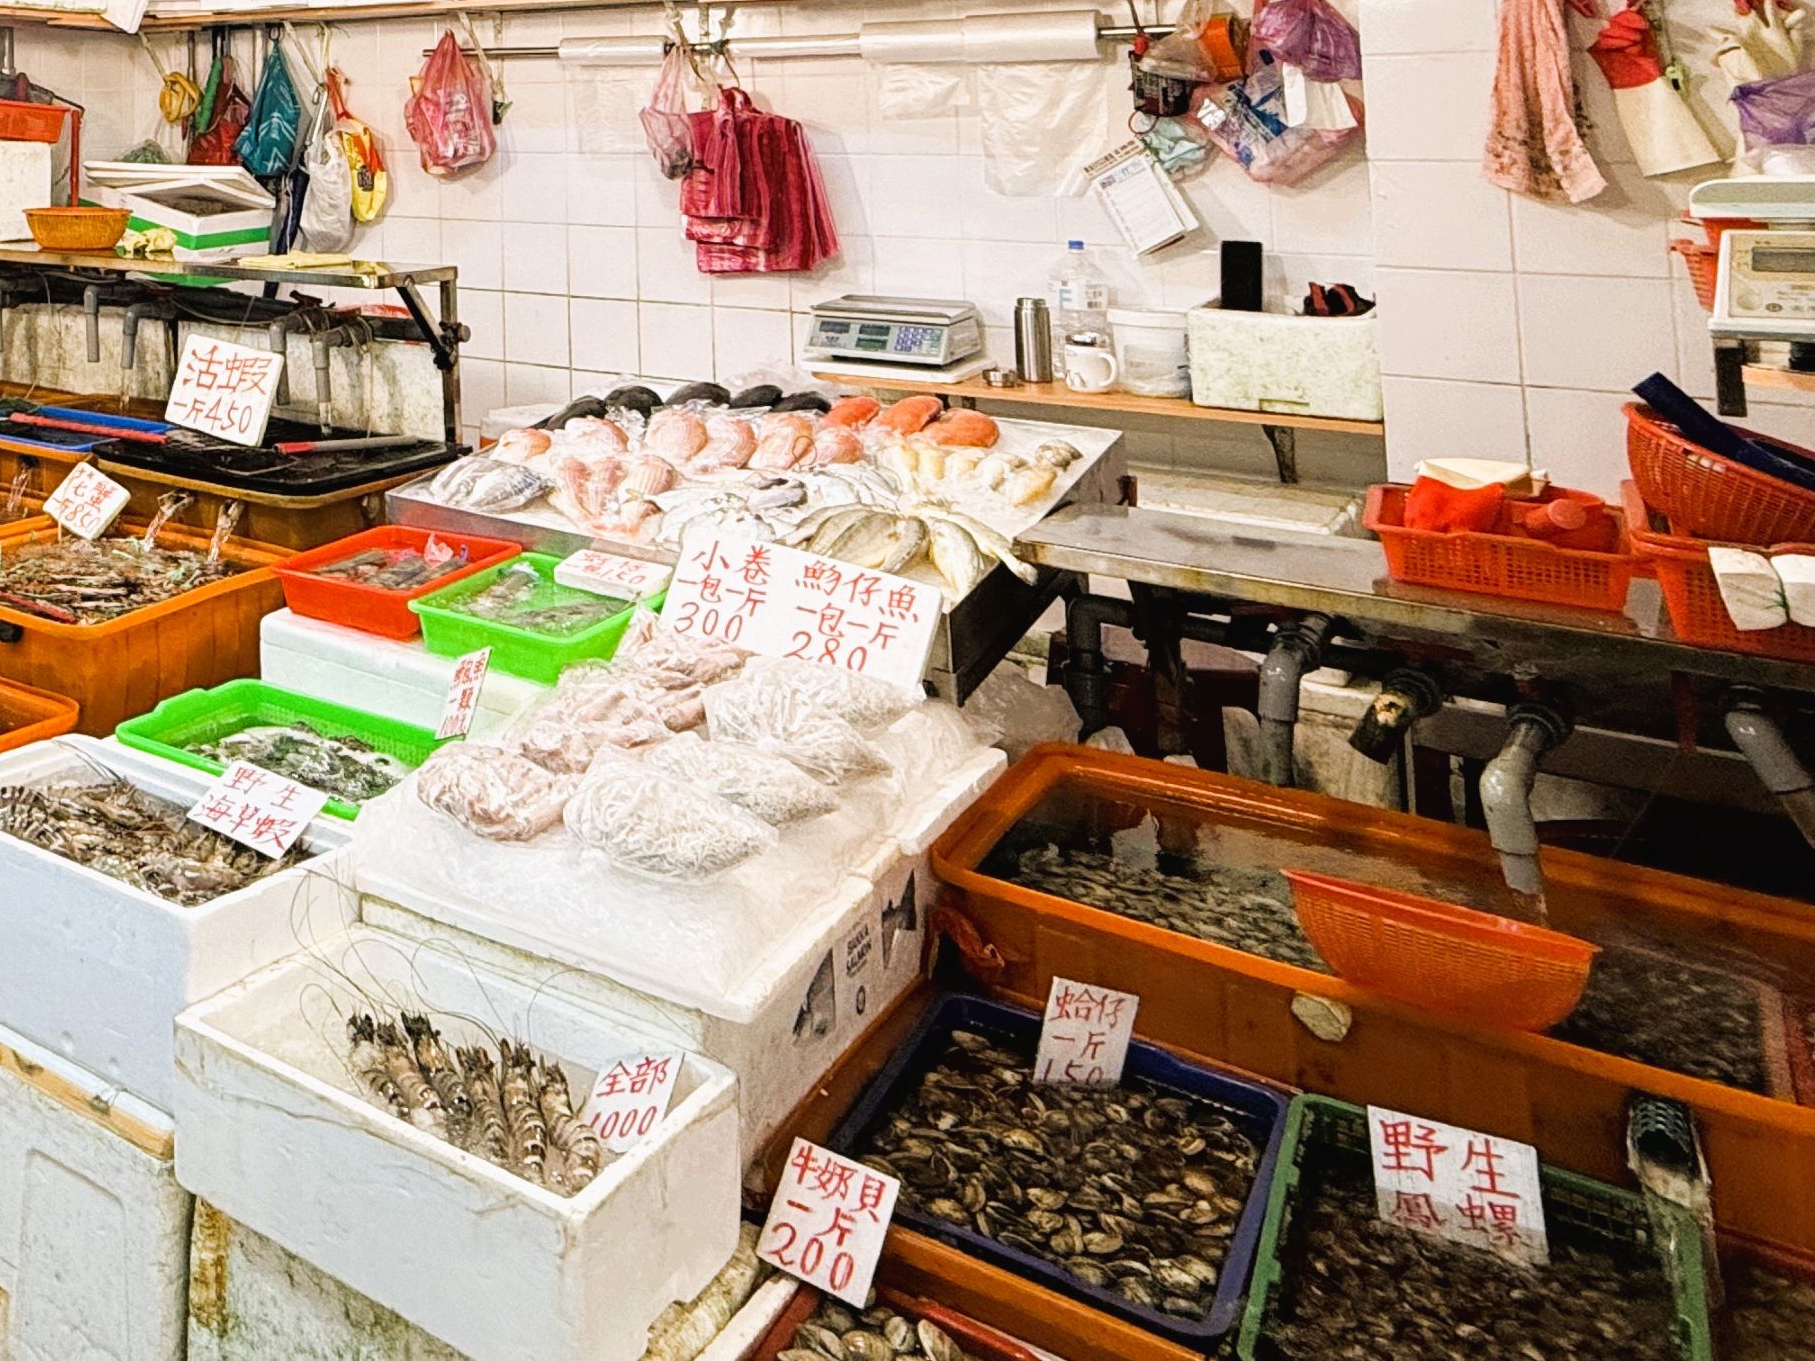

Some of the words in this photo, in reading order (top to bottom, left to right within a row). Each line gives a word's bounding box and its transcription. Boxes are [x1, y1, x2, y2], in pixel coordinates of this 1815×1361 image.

[182, 344, 272, 395] 活蝦
[173, 396, 252, 434] 一斤450
[691, 540, 772, 587] 小卷
[677, 573, 767, 617] 一包一斤
[795, 559, 919, 623] 魩仔魚
[673, 601, 743, 642] 300
[795, 601, 900, 650] 一包一斤
[783, 630, 868, 672] 280
[223, 766, 301, 812] 野生
[1048, 985, 1126, 1029] 蛤仔
[1052, 1031, 1106, 1060] 一斤
[597, 1055, 671, 1097] 全部
[1043, 1059, 1104, 1084] 150
[590, 1105, 657, 1140] 1000
[1379, 1118, 1521, 1199] 野生
[790, 1144, 887, 1223] 牛奶貝
[787, 1199, 858, 1247] 一斤
[768, 1221, 855, 1292] 200
